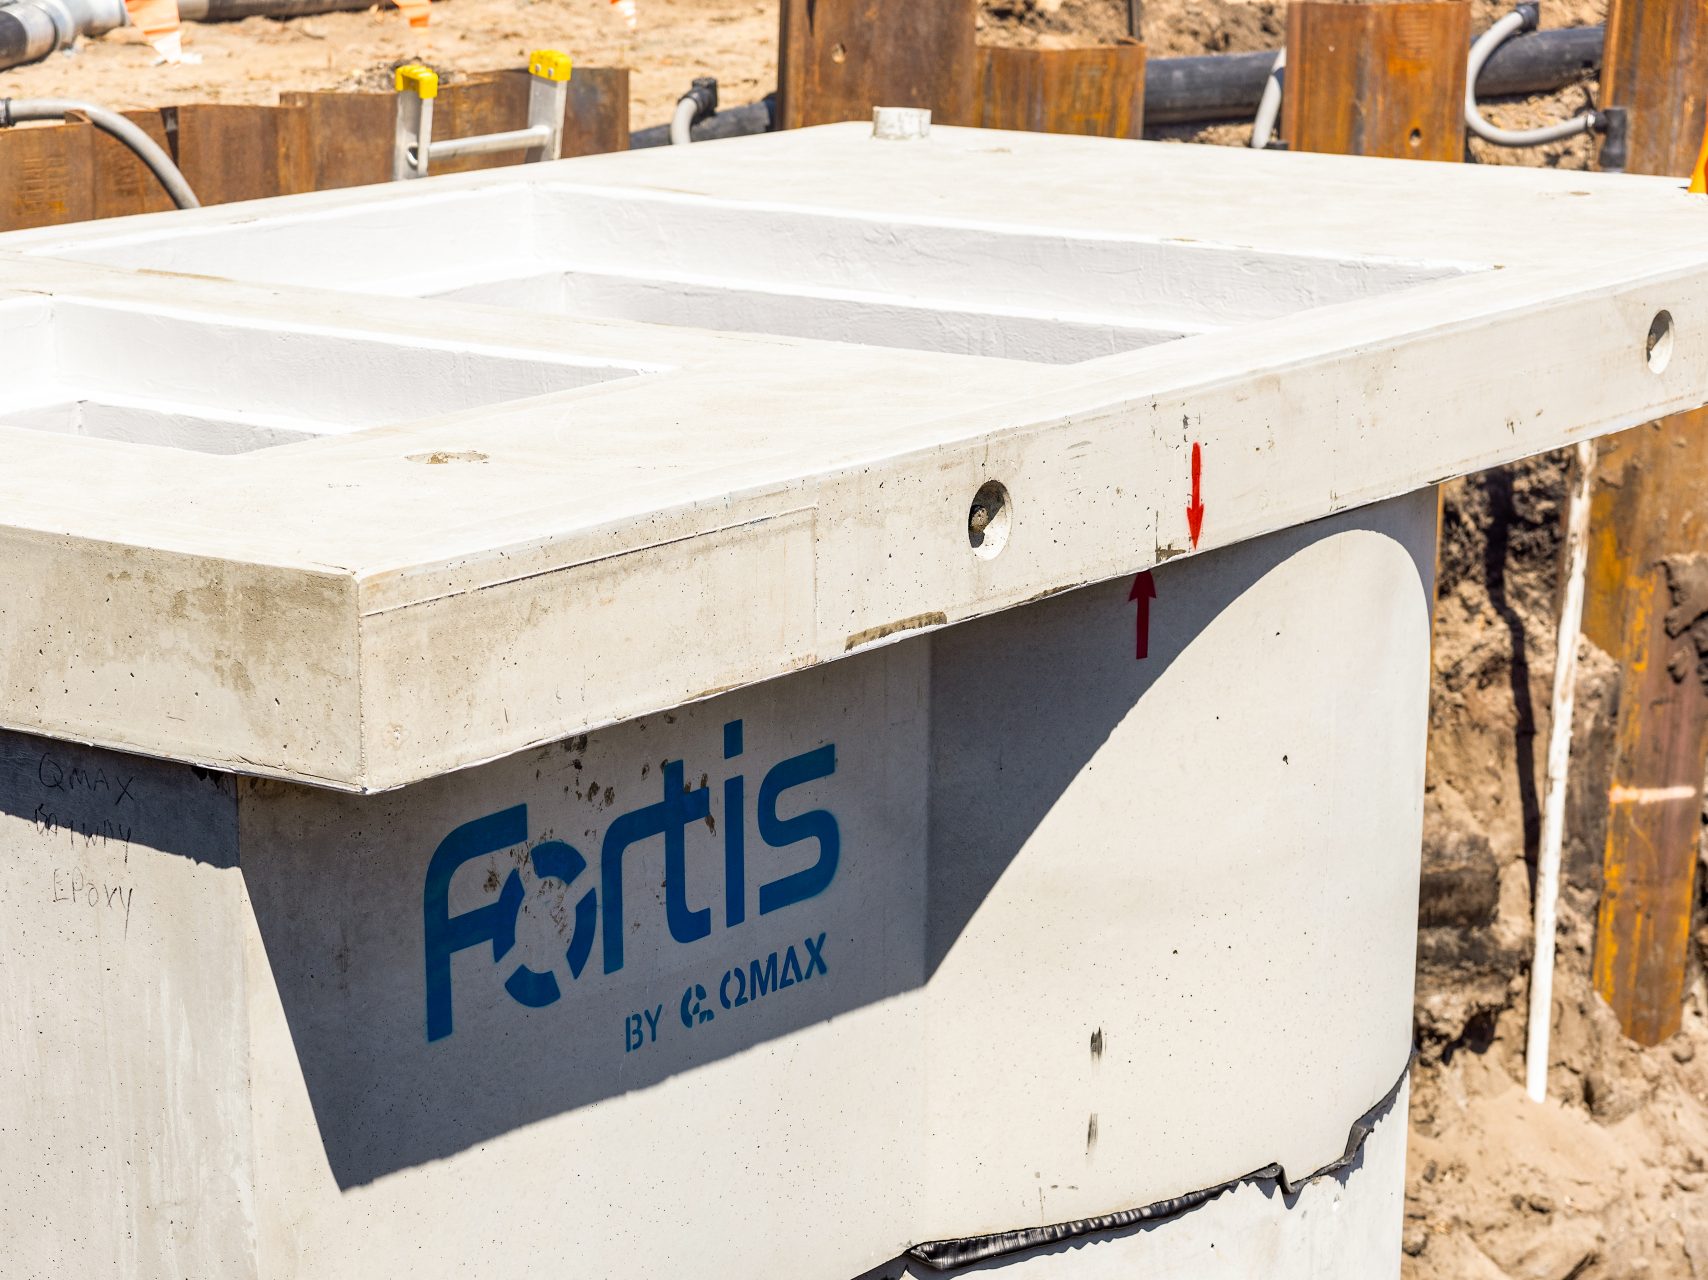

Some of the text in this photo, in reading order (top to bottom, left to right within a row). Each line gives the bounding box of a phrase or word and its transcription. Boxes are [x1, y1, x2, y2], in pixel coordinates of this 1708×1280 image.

[38, 752, 135, 805] QMAX
[424, 719, 841, 1043] Fortis
[625, 932, 828, 1052] BY QMAX
